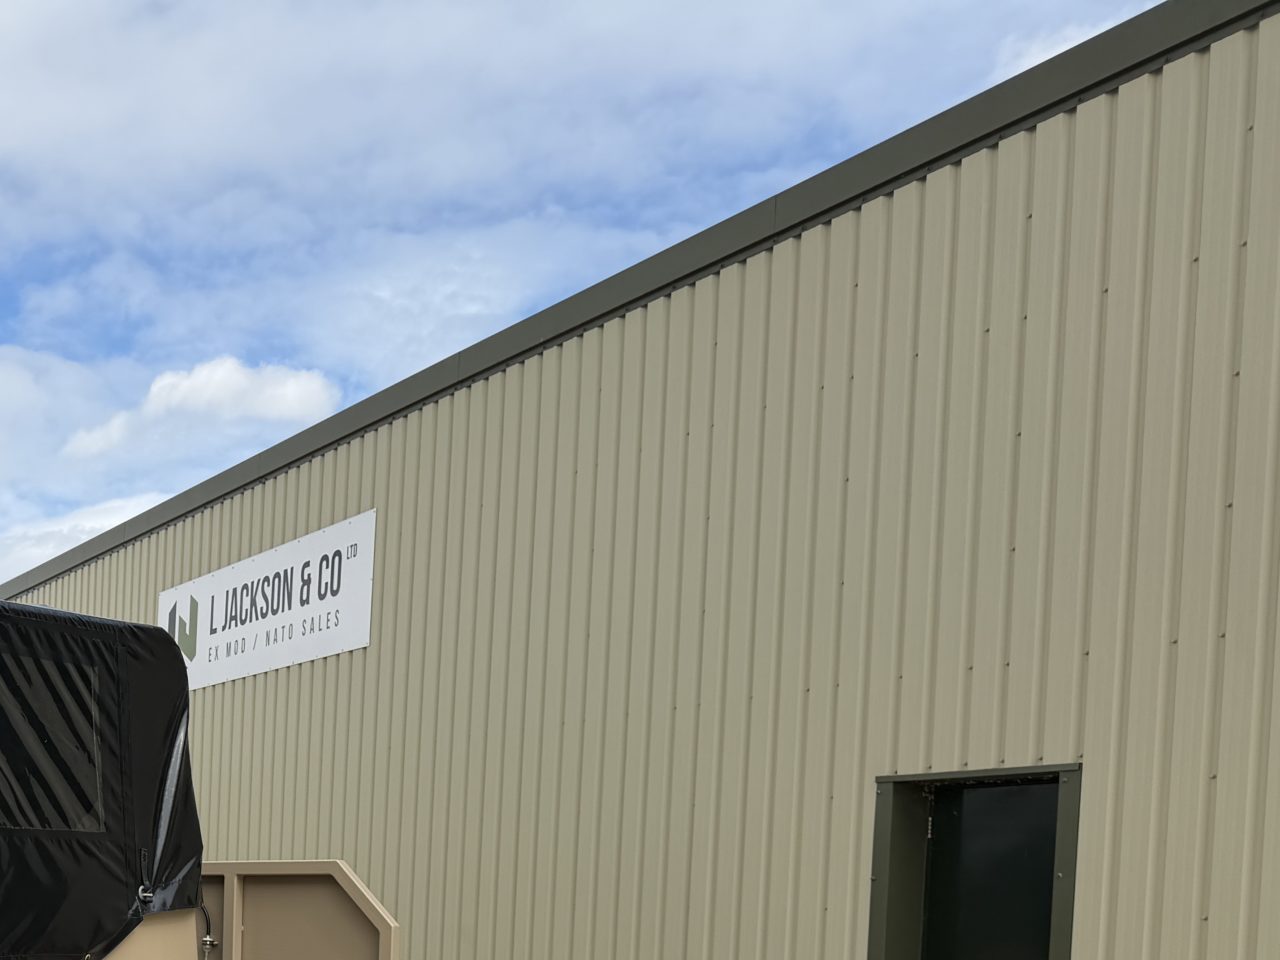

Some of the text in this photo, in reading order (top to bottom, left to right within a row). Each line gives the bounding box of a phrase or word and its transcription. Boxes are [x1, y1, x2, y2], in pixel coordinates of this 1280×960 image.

[209, 543, 358, 635] L JACKSON & CO LTD
[208, 646, 219, 662] EX
[226, 637, 246, 658] MOD
[265, 623, 293, 647] NATO
[302, 609, 340, 637] SALES
